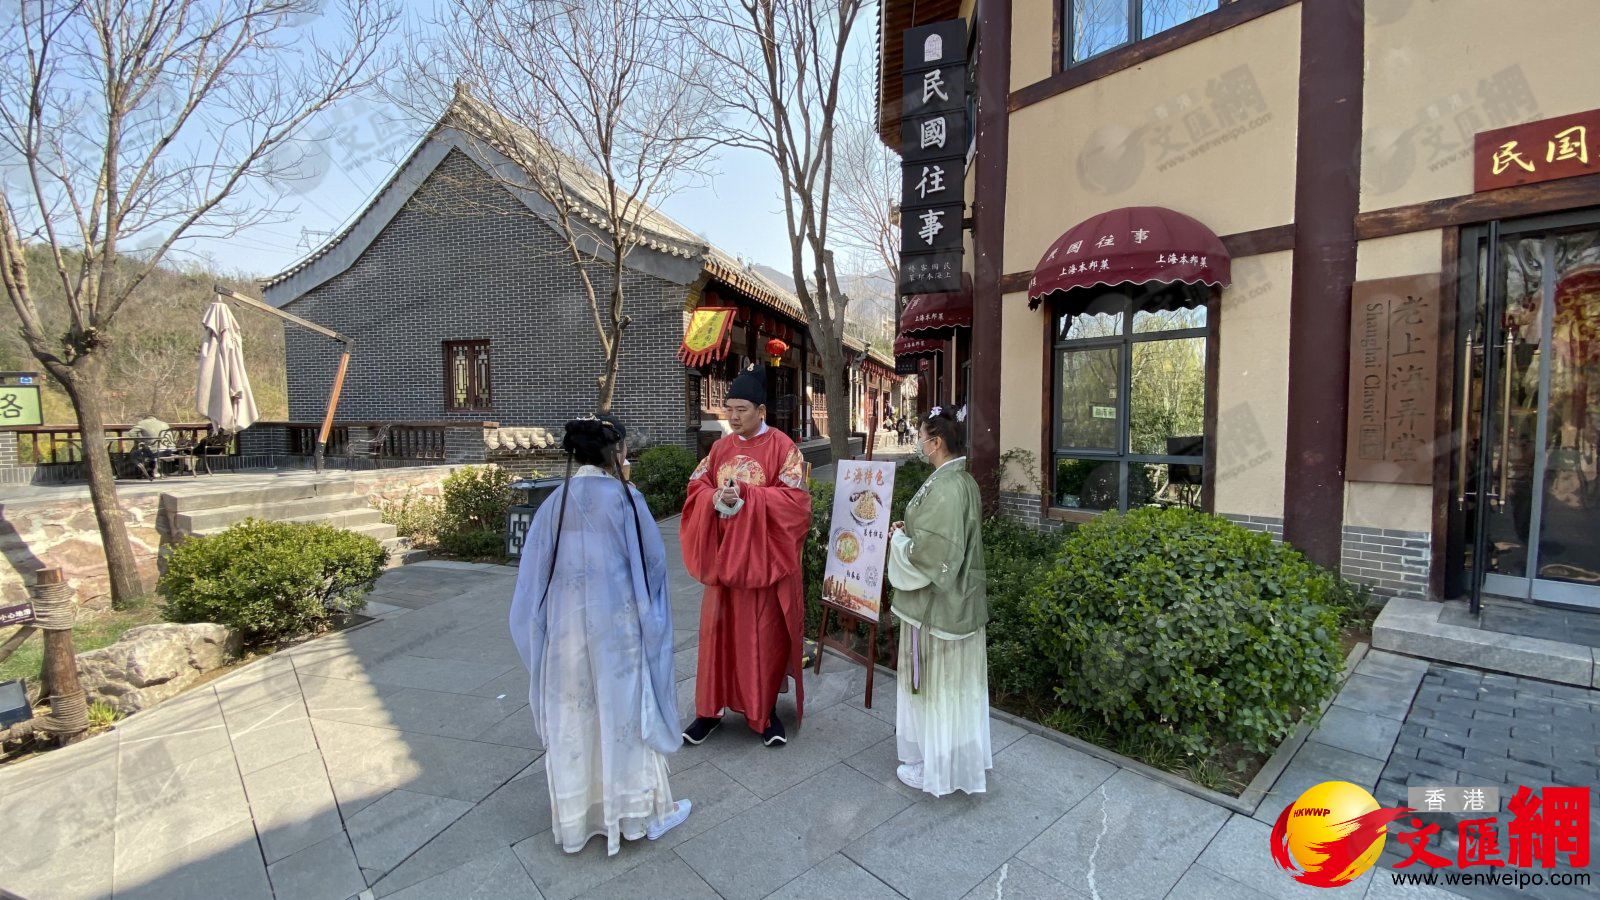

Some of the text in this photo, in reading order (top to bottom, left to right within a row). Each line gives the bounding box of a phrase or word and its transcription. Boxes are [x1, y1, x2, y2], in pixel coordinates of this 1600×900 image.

[915, 69, 948, 245] 民國往事
[1492, 125, 1588, 175] 民国
[1059, 258, 1111, 277] 上海本邦菜
[1155, 253, 1208, 270] 上海本邦菜
[1360, 303, 1383, 369] Shanghai
[1362, 375, 1382, 424] Classic
